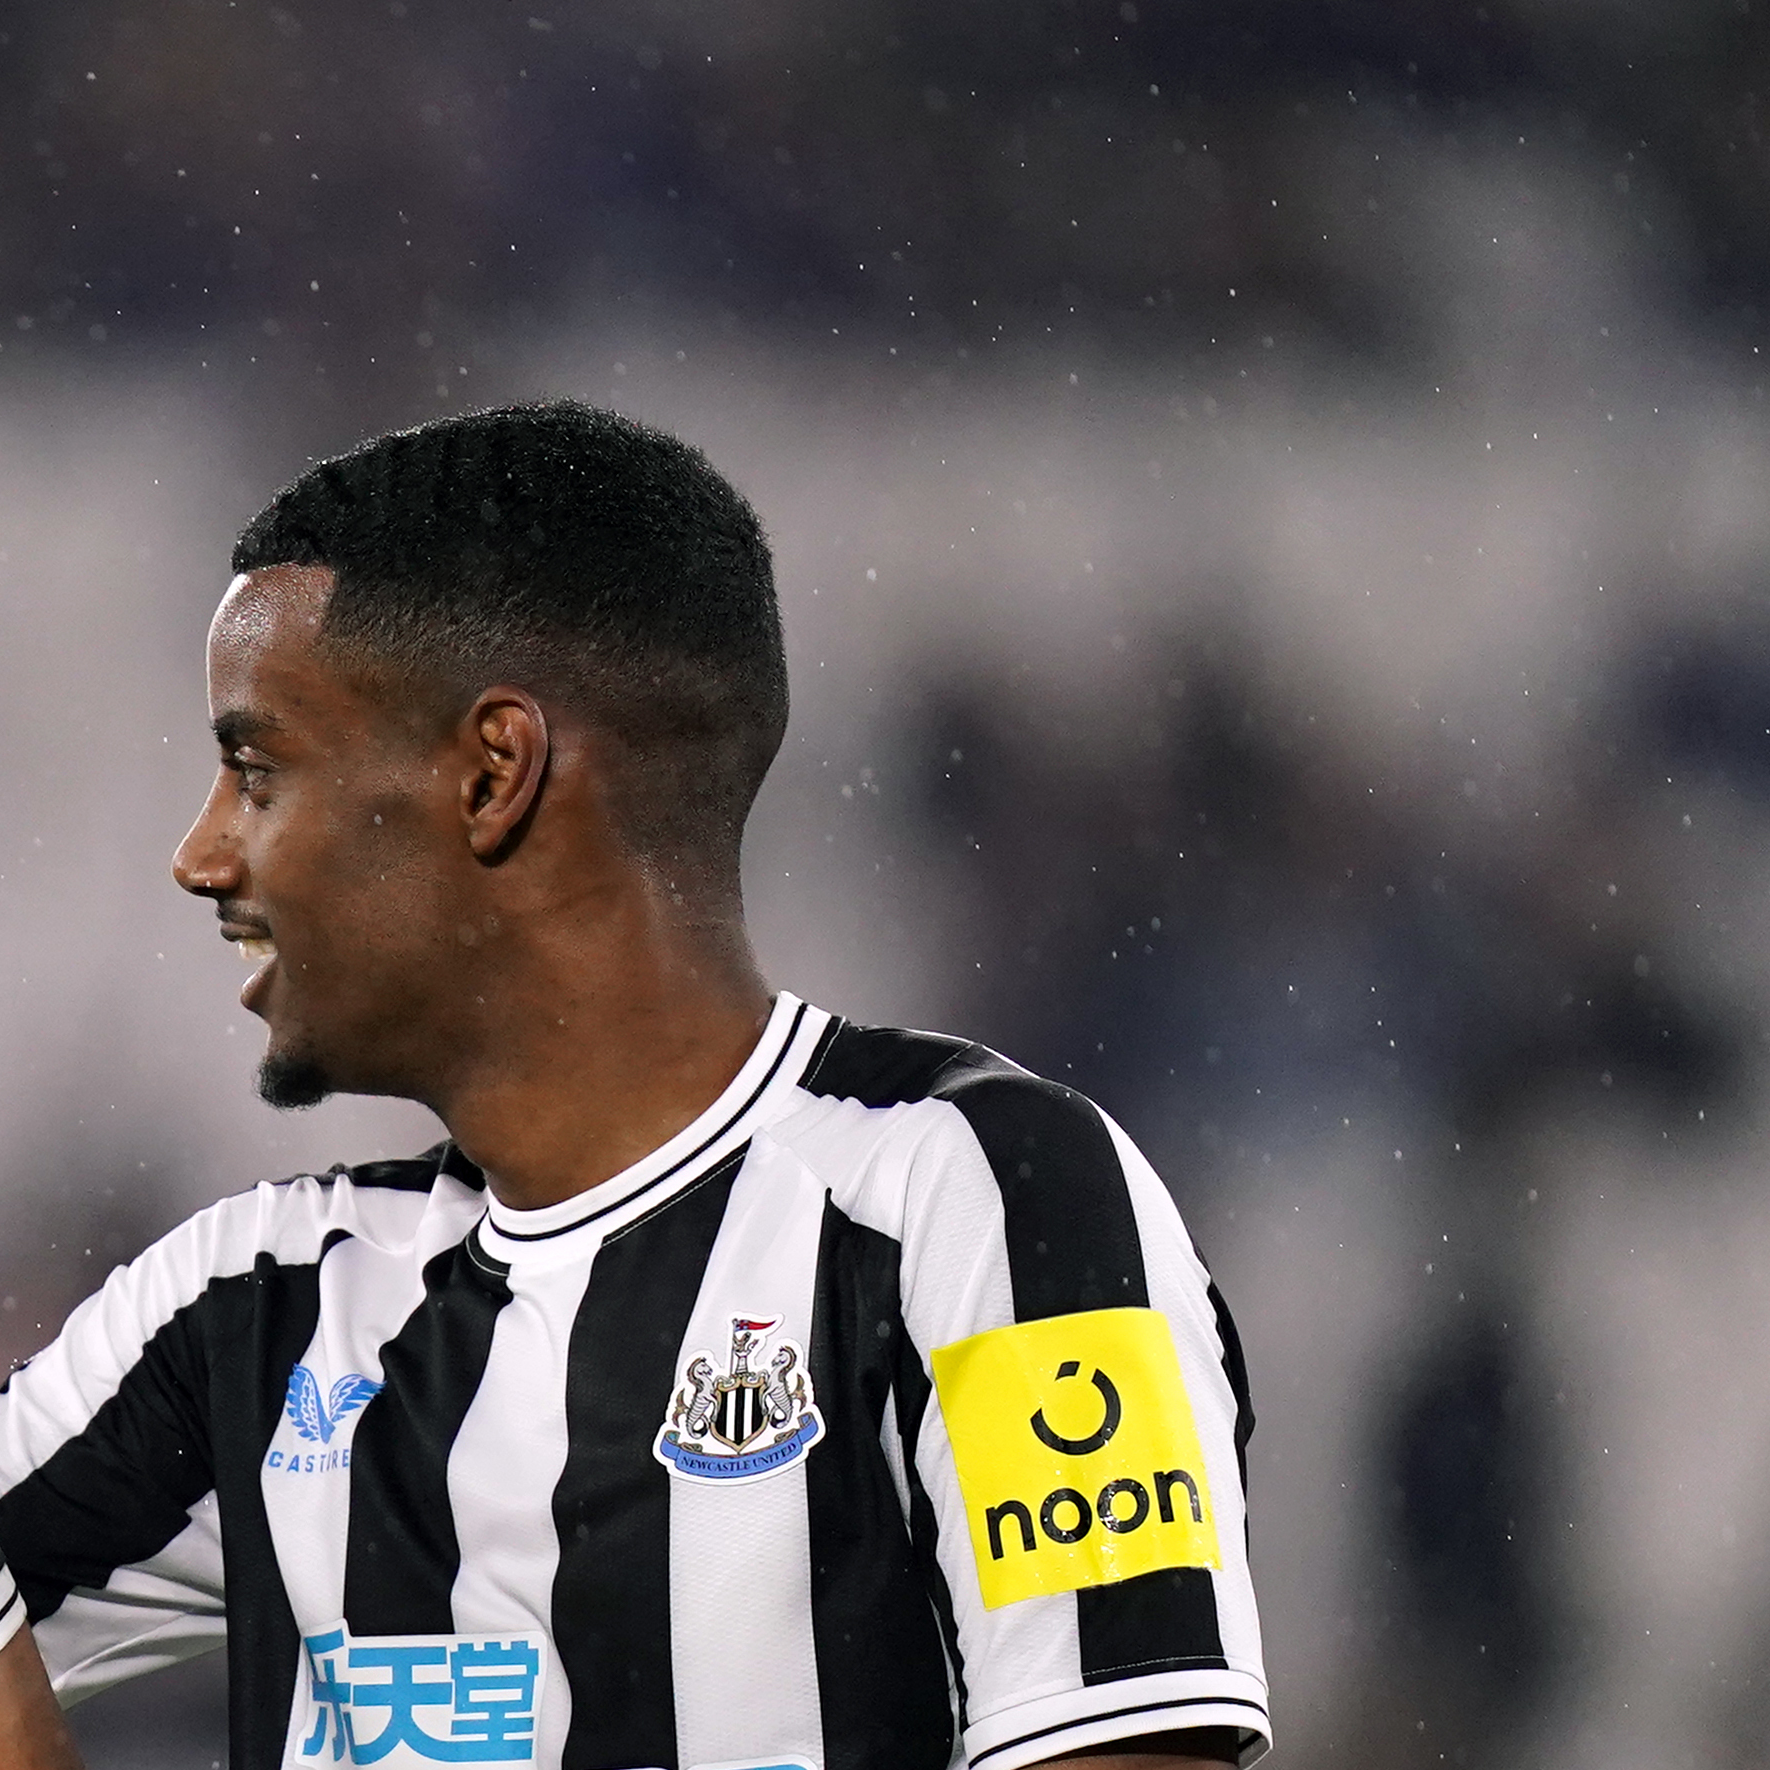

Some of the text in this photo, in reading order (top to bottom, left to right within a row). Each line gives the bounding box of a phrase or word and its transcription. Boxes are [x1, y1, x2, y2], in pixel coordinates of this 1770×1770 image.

[268, 1448, 350, 1473] CASTRE
[681, 1442, 797, 1473] NEWCASTLE UNITED
[986, 1469, 1203, 1561] noon
[302, 1628, 539, 1766] 乐天堂
